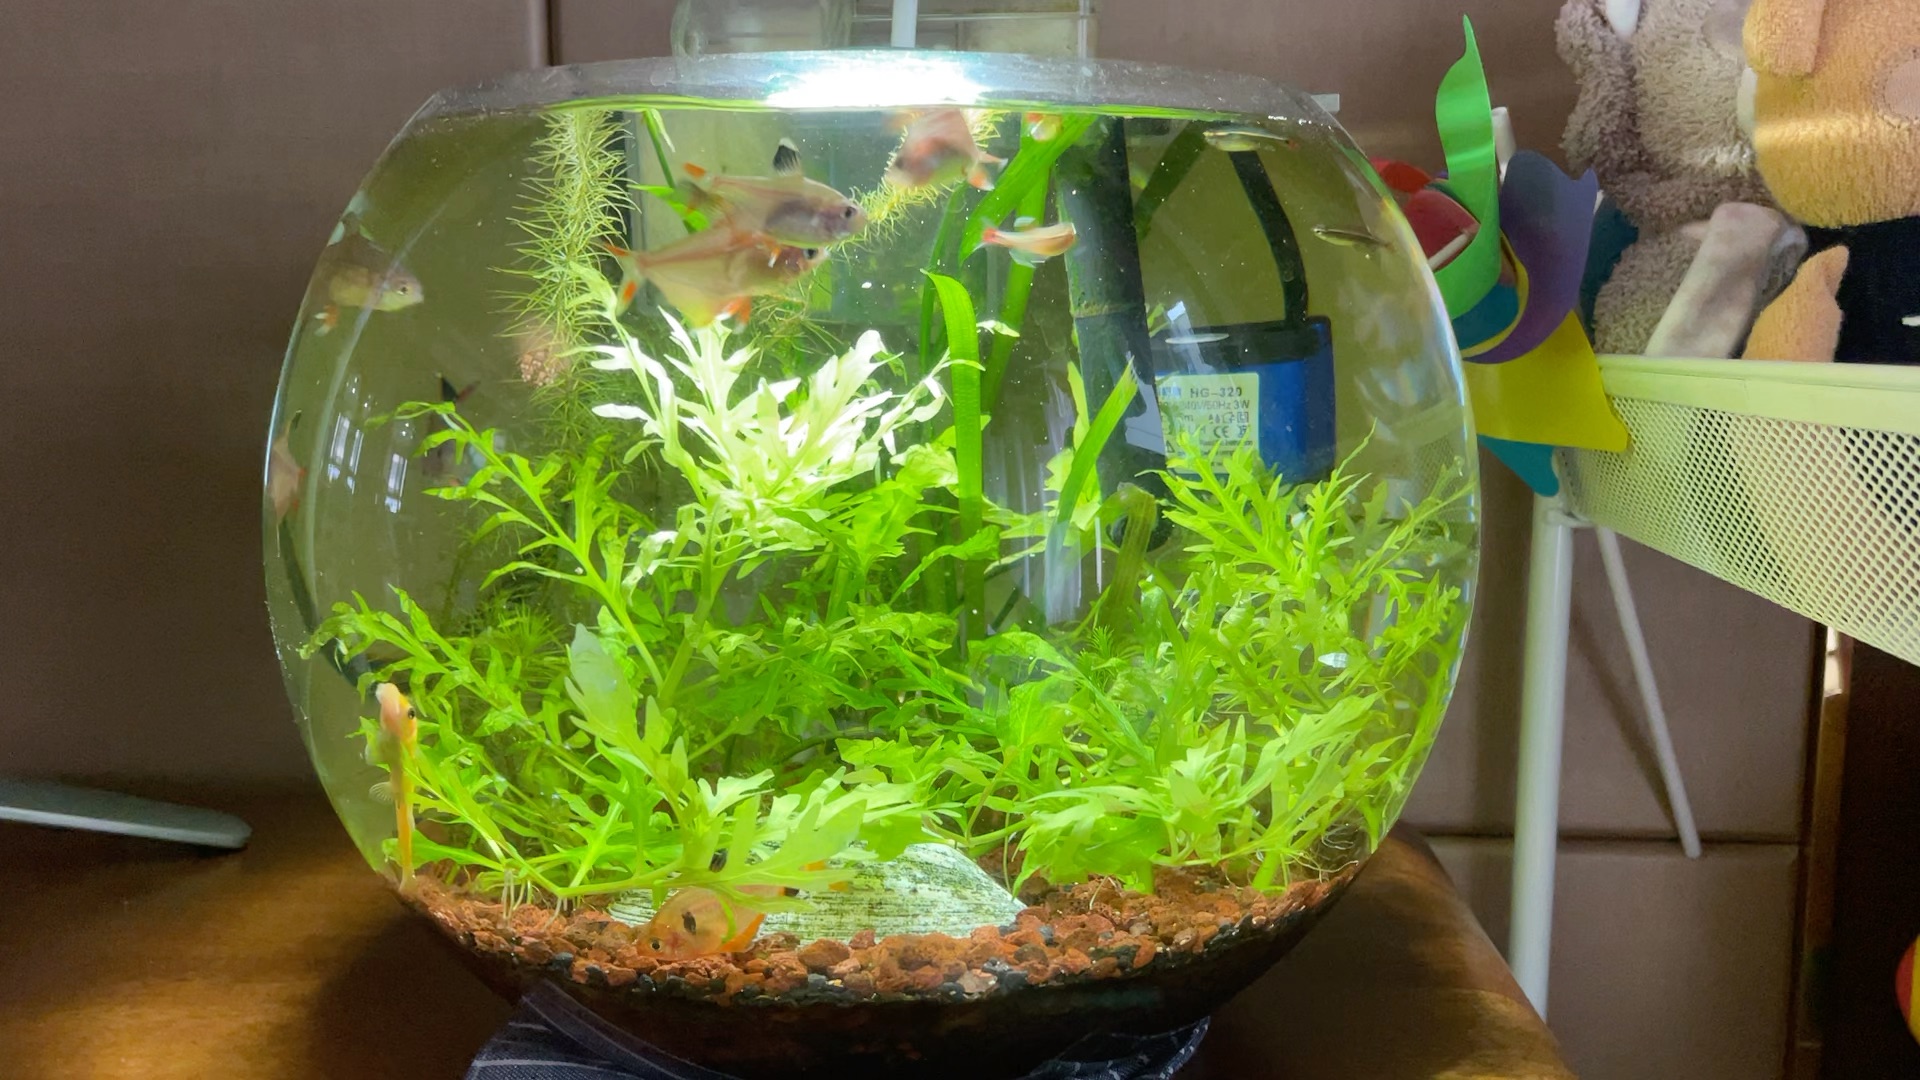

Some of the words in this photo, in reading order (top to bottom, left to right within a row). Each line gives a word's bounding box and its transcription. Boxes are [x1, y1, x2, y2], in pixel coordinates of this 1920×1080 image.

[1190, 387, 1242, 398] HG-320
[1182, 400, 1231, 410] 40V/50Hz
[1234, 400, 1249, 409] 3W
